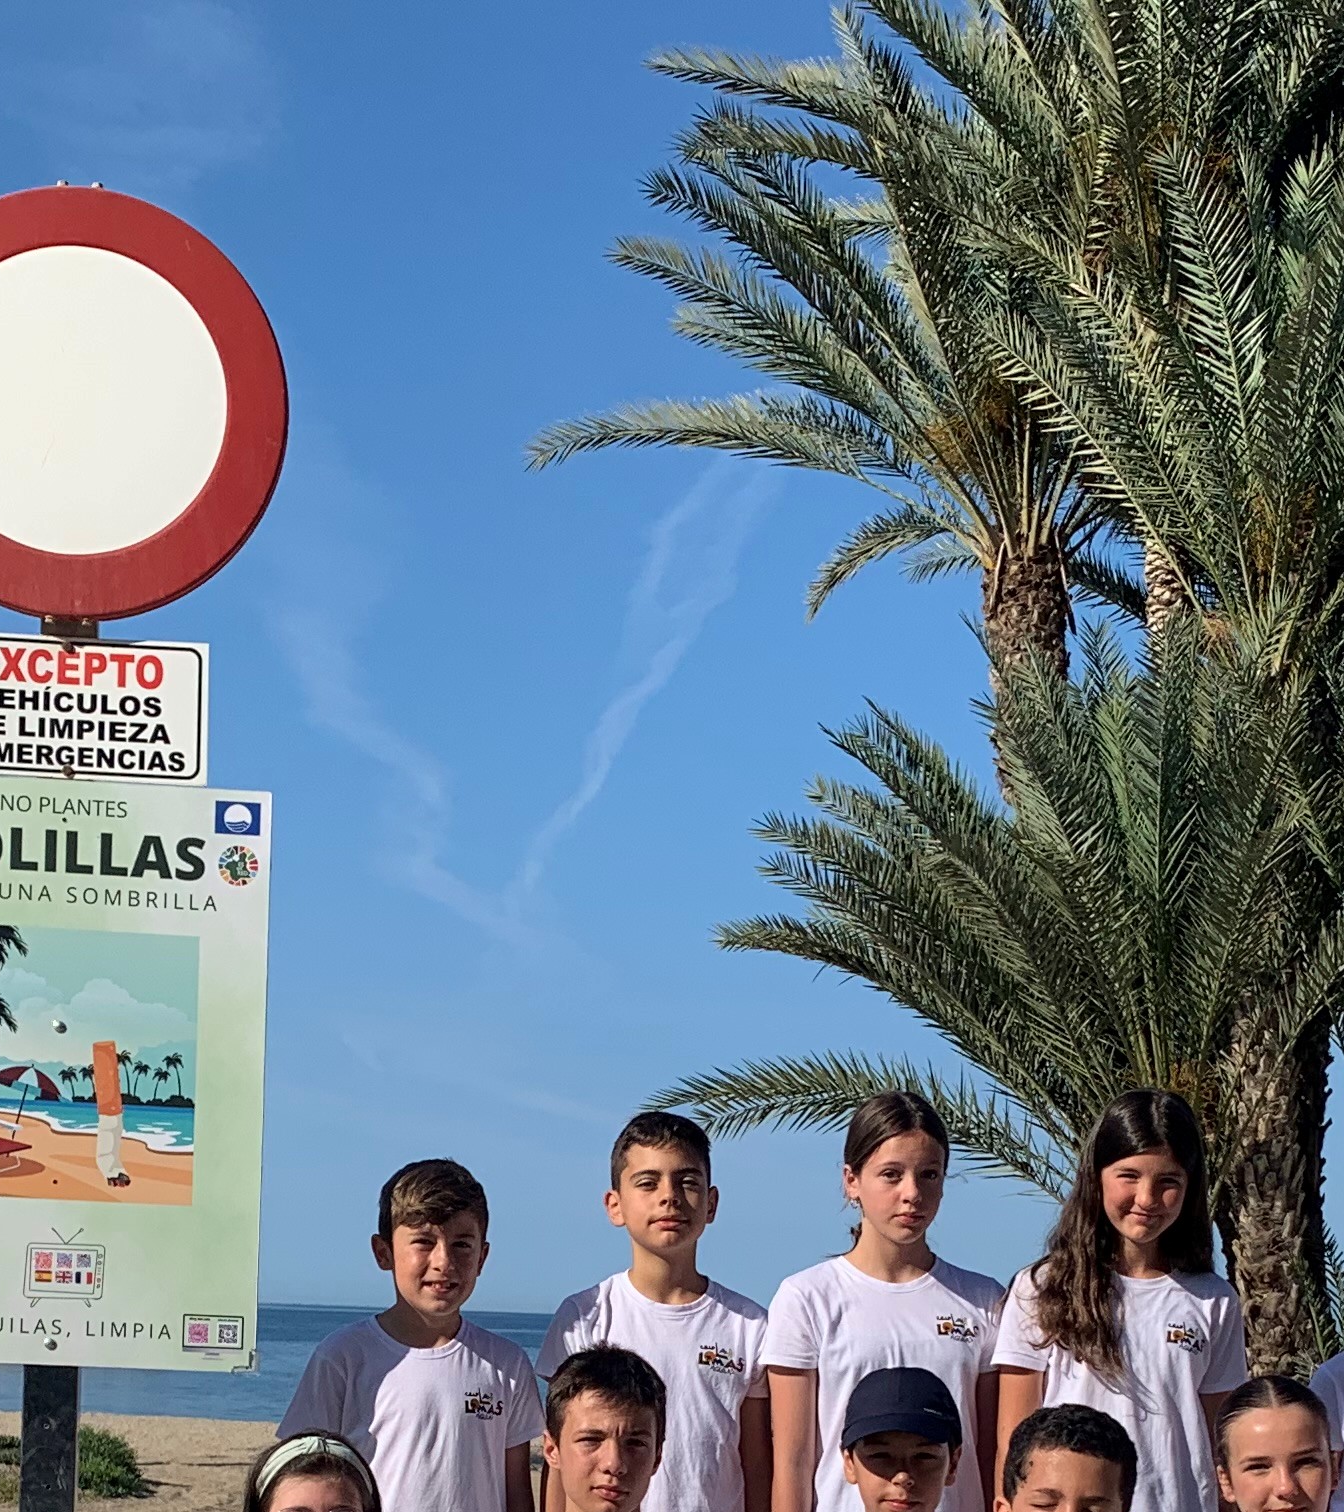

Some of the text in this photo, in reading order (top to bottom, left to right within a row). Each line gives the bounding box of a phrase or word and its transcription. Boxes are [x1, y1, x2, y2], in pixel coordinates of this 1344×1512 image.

[19, 716, 171, 745] LIMPIEZA
[0, 794, 128, 819] NO PLANTES
[66, 886, 217, 912] SOMBRILLA
[85, 1321, 172, 1341] LIMPIA
